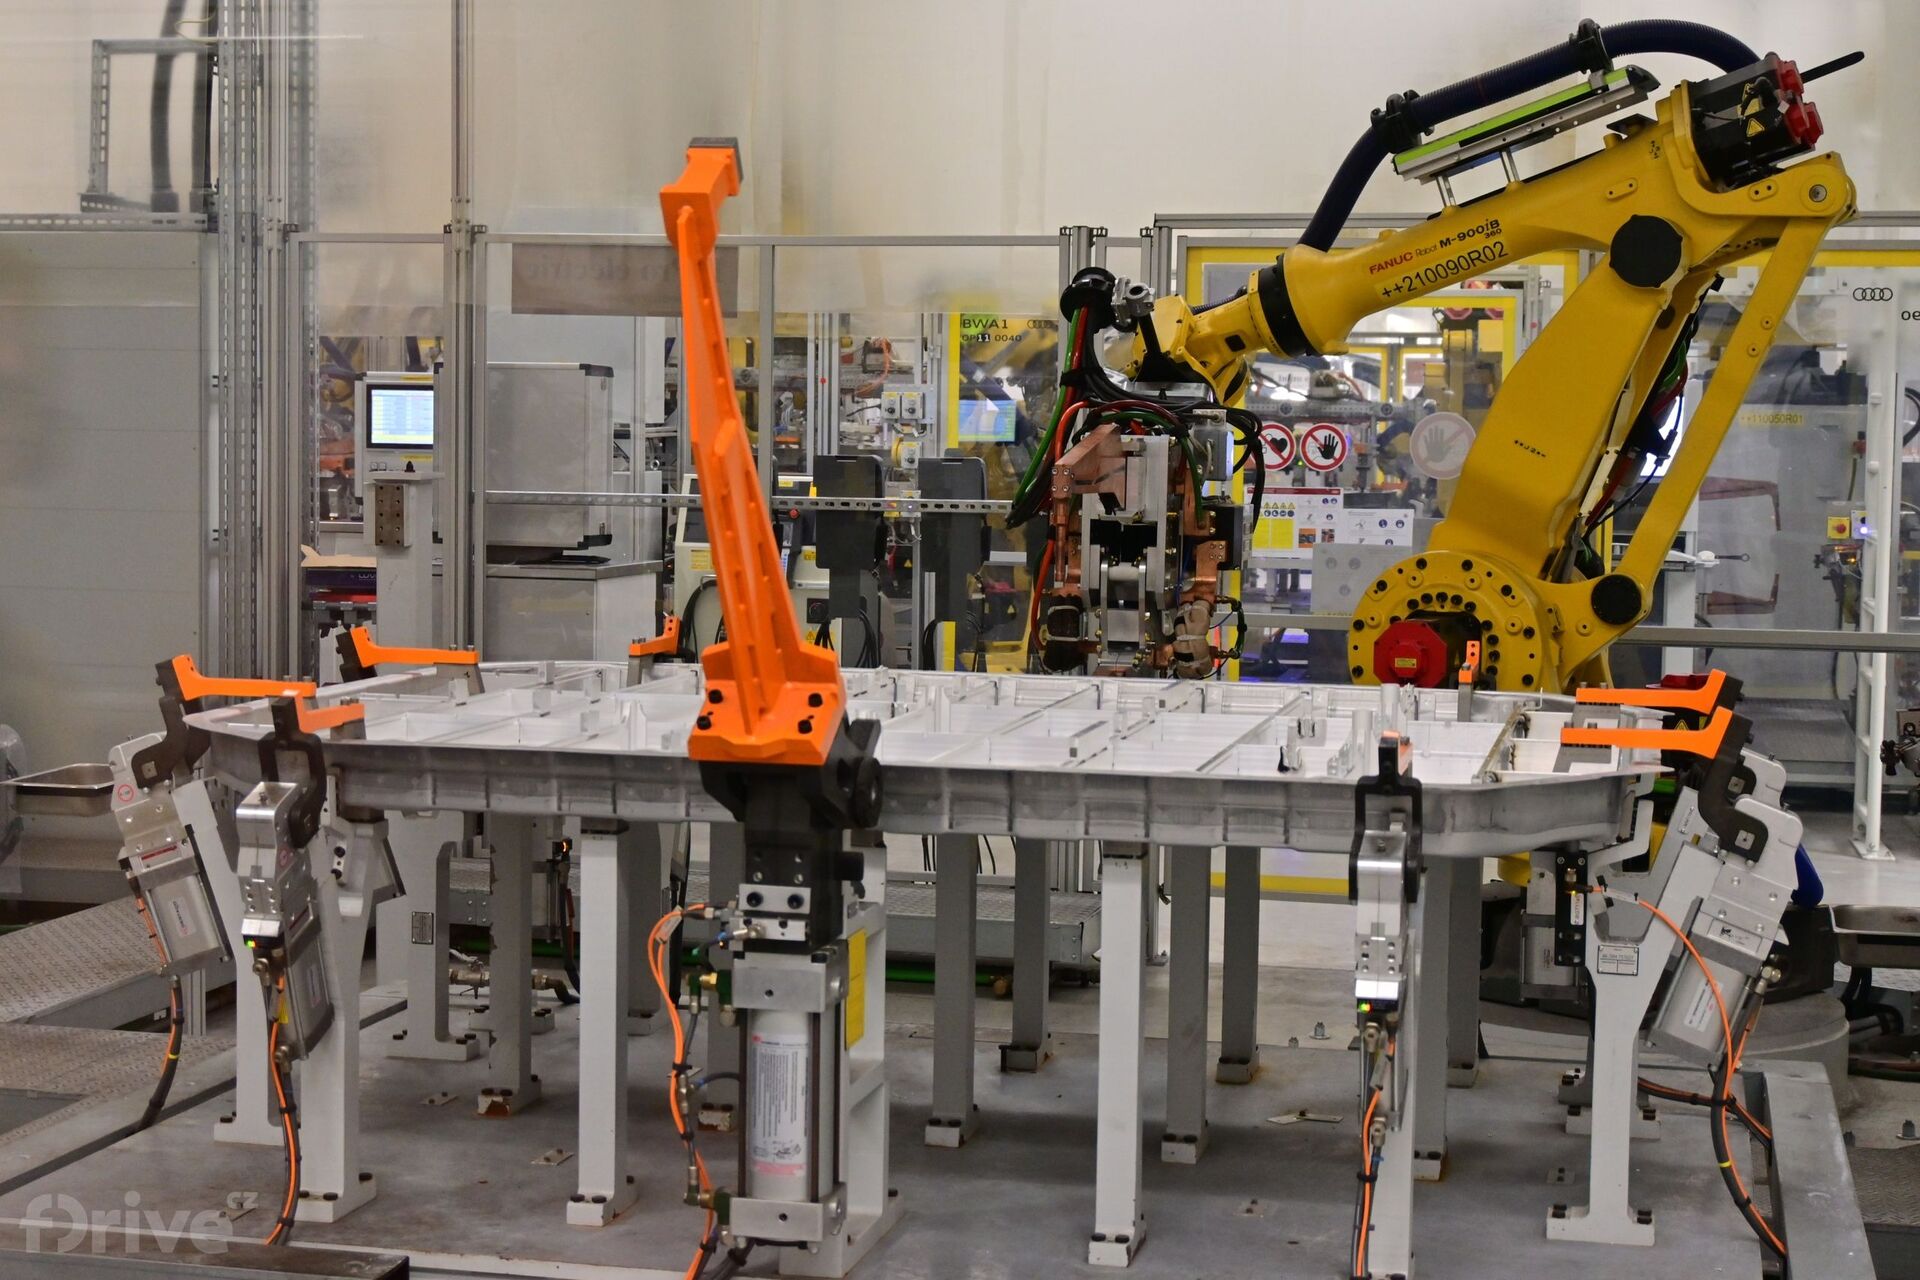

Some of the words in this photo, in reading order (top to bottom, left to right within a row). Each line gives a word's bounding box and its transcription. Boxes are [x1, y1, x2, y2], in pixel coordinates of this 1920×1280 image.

[1369, 251, 1414, 275] FANUC
[1439, 218, 1500, 249] M-900iB
[1382, 240, 1509, 298] ++210090R02
